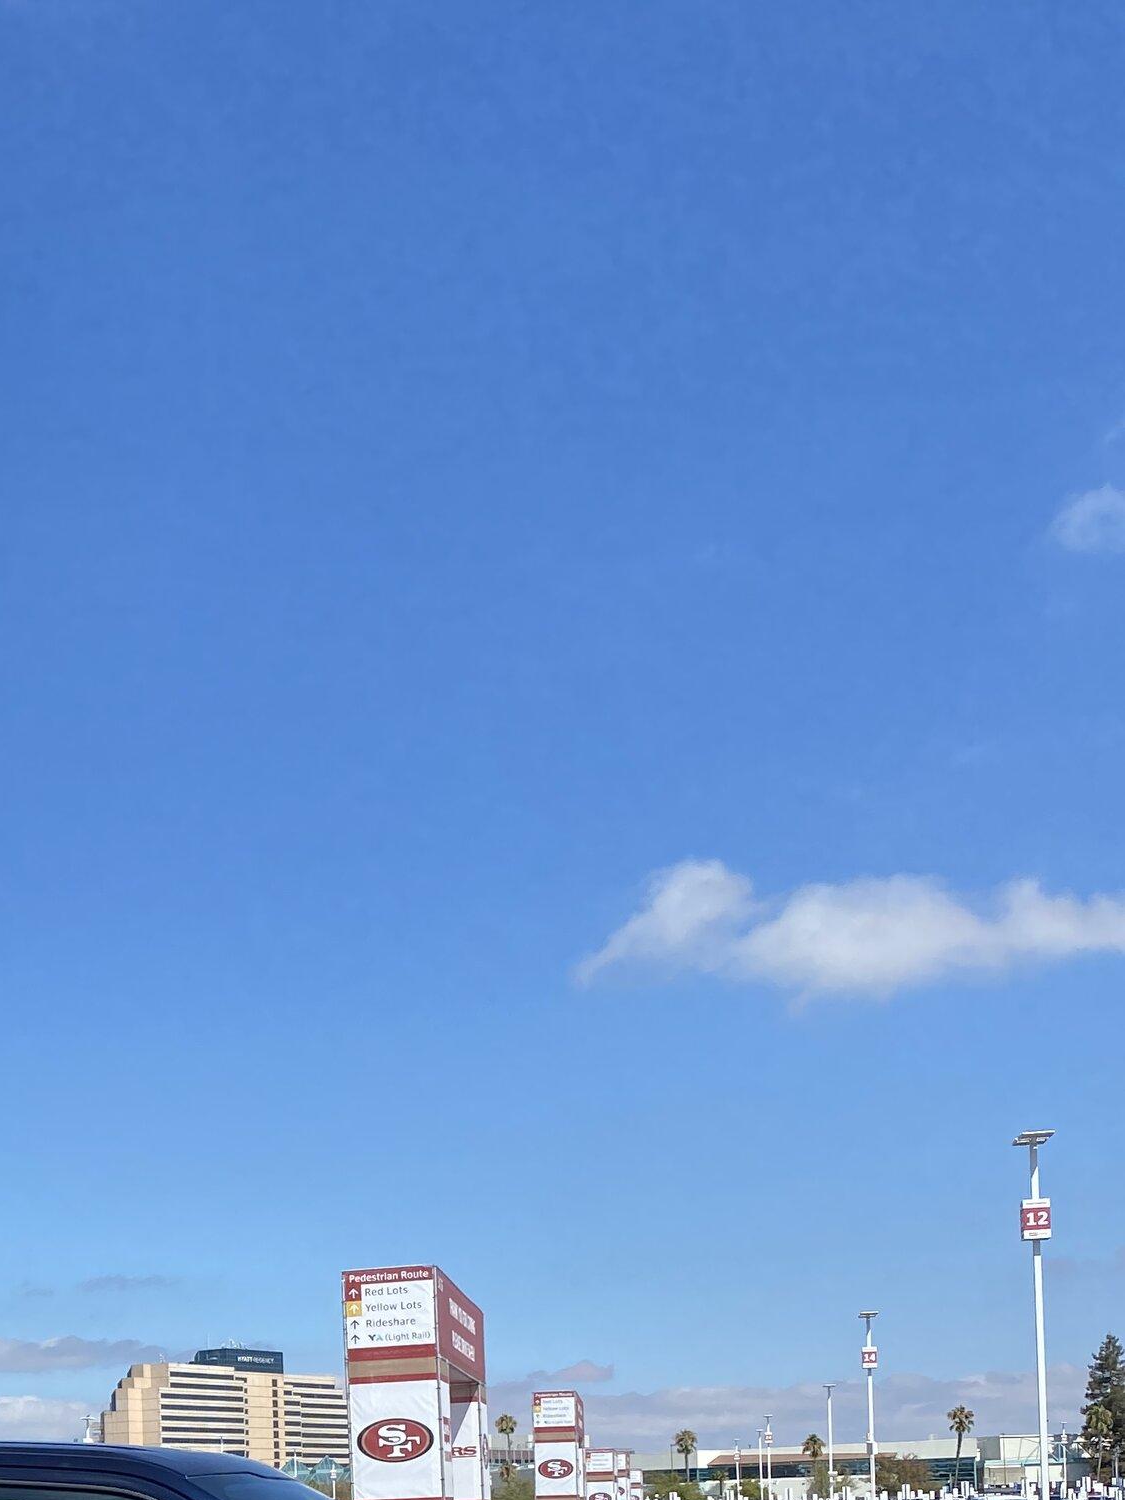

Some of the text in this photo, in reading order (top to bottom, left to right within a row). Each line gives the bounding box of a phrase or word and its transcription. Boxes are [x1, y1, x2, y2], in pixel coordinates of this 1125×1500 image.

[1026, 1211, 1049, 1226] 12
[349, 1270, 429, 1283] Pedestrian Route
[365, 1286, 408, 1297] Red Lots
[365, 1301, 422, 1312] Yellow Lots
[366, 1318, 416, 1328] Rideshare
[385, 1332, 409, 1342] (Light
[411, 1331, 431, 1340] Rail)
[864, 1353, 876, 1362] 14
[377, 1423, 421, 1458] SF
